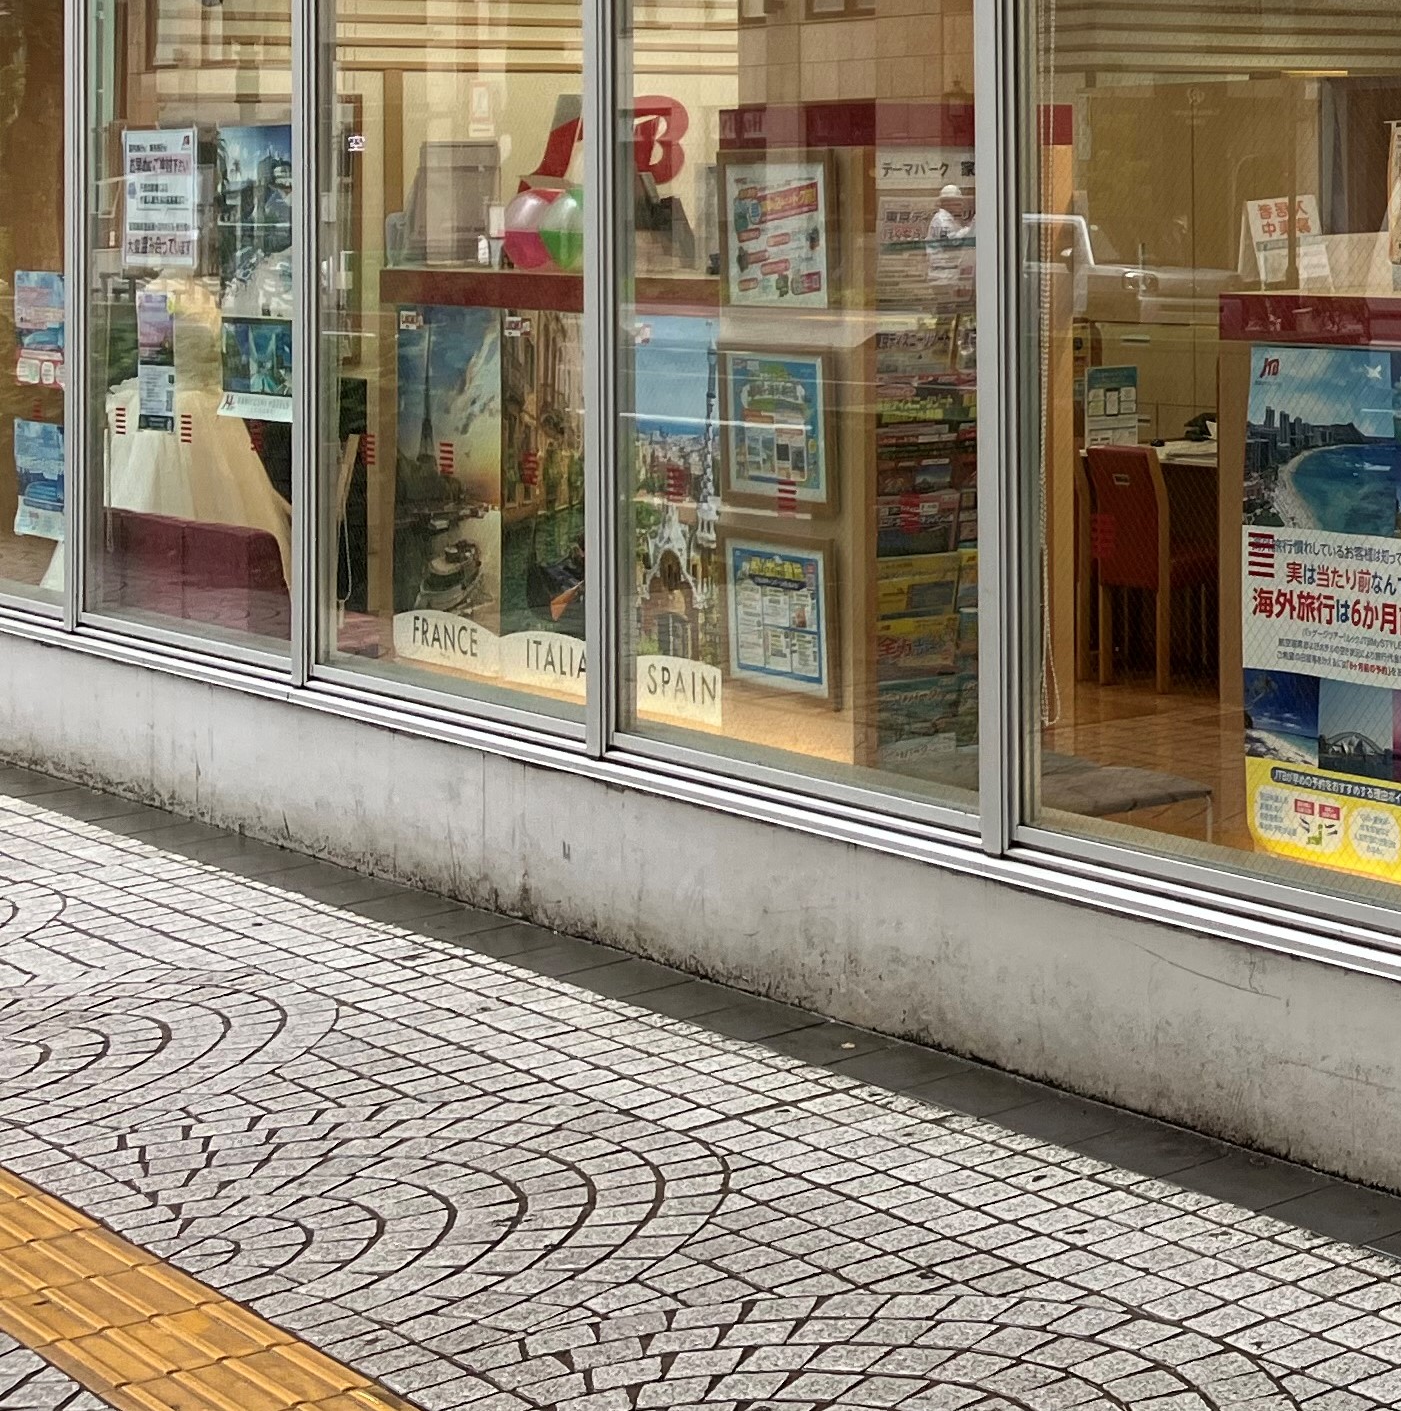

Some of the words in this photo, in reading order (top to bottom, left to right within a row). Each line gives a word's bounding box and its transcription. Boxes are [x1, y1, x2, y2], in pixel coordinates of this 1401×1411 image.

[882, 161, 949, 177] テーマパーク
[1260, 357, 1280, 378] JTB
[413, 616, 478, 657] FRANCE
[647, 664, 717, 705] SPAIN
